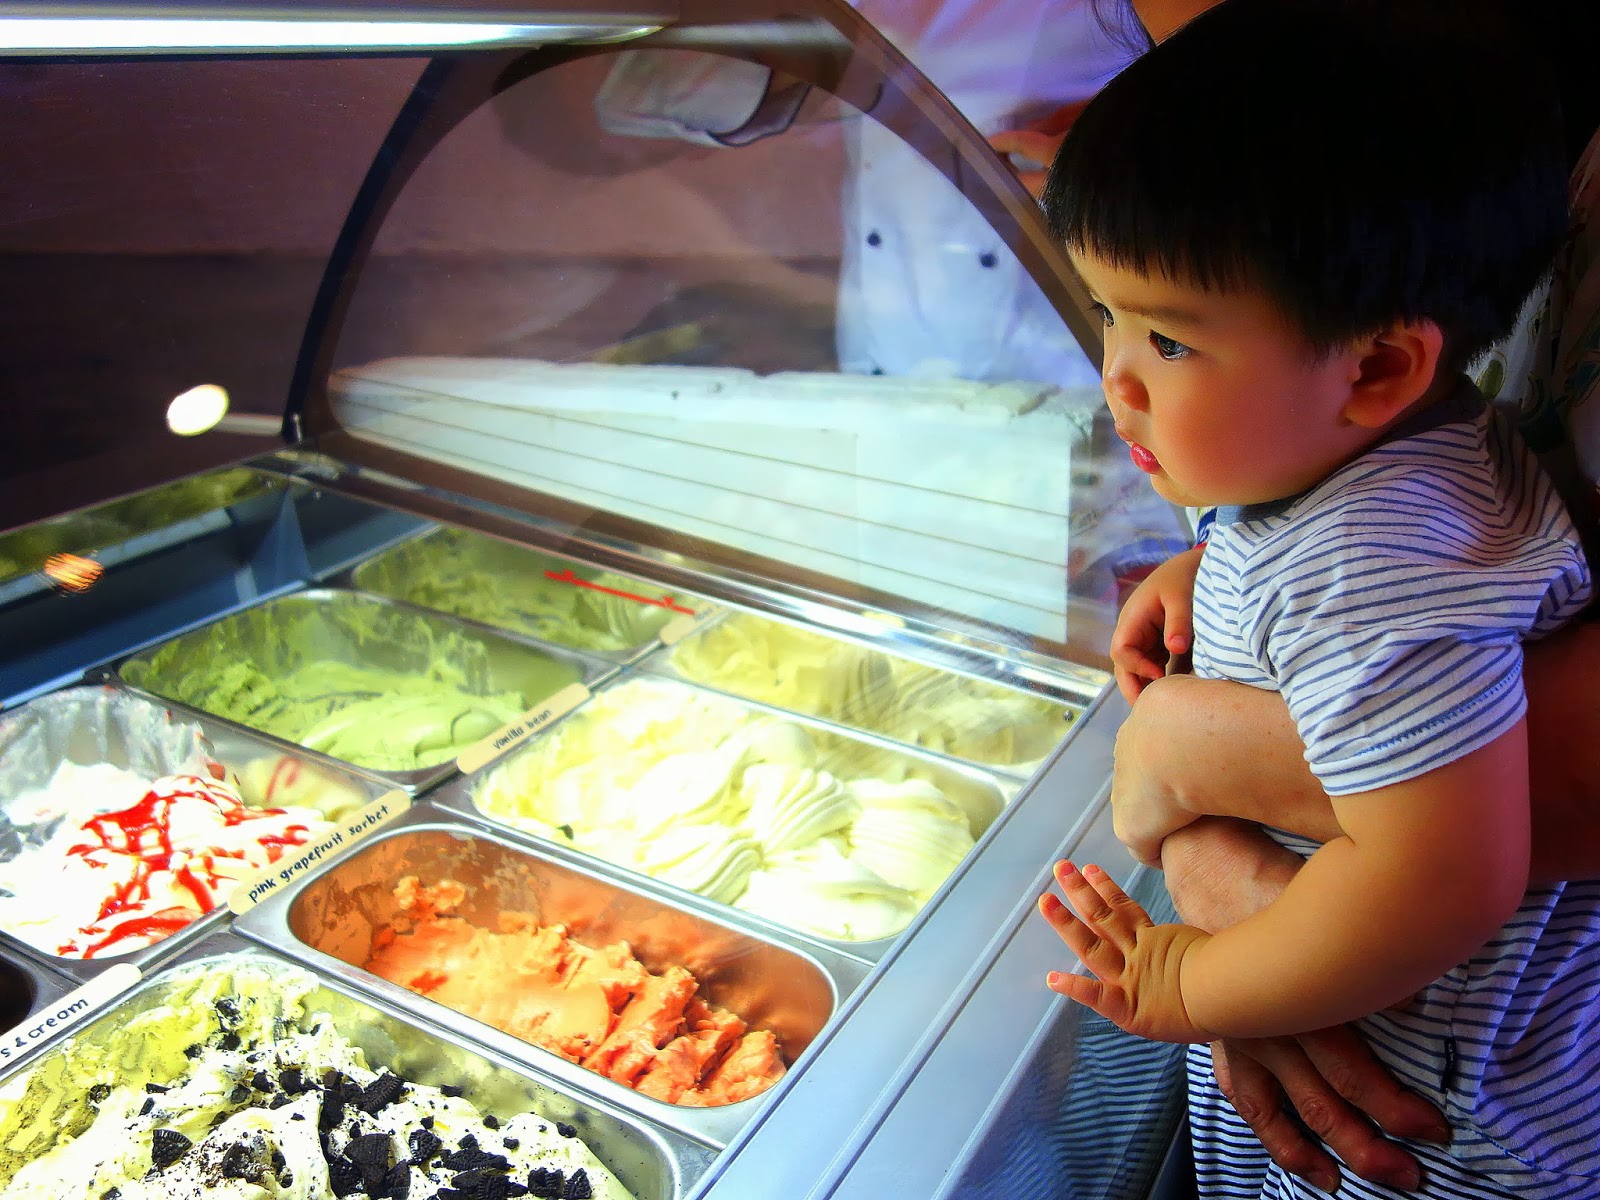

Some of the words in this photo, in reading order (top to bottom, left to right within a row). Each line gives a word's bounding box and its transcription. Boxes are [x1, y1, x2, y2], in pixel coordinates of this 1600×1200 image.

[525, 710, 552, 728] bean
[249, 878, 276, 903] pink
[280, 832, 344, 882] grapefruit
[348, 805, 389, 836] sorbet
[28, 999, 89, 1039] cream
